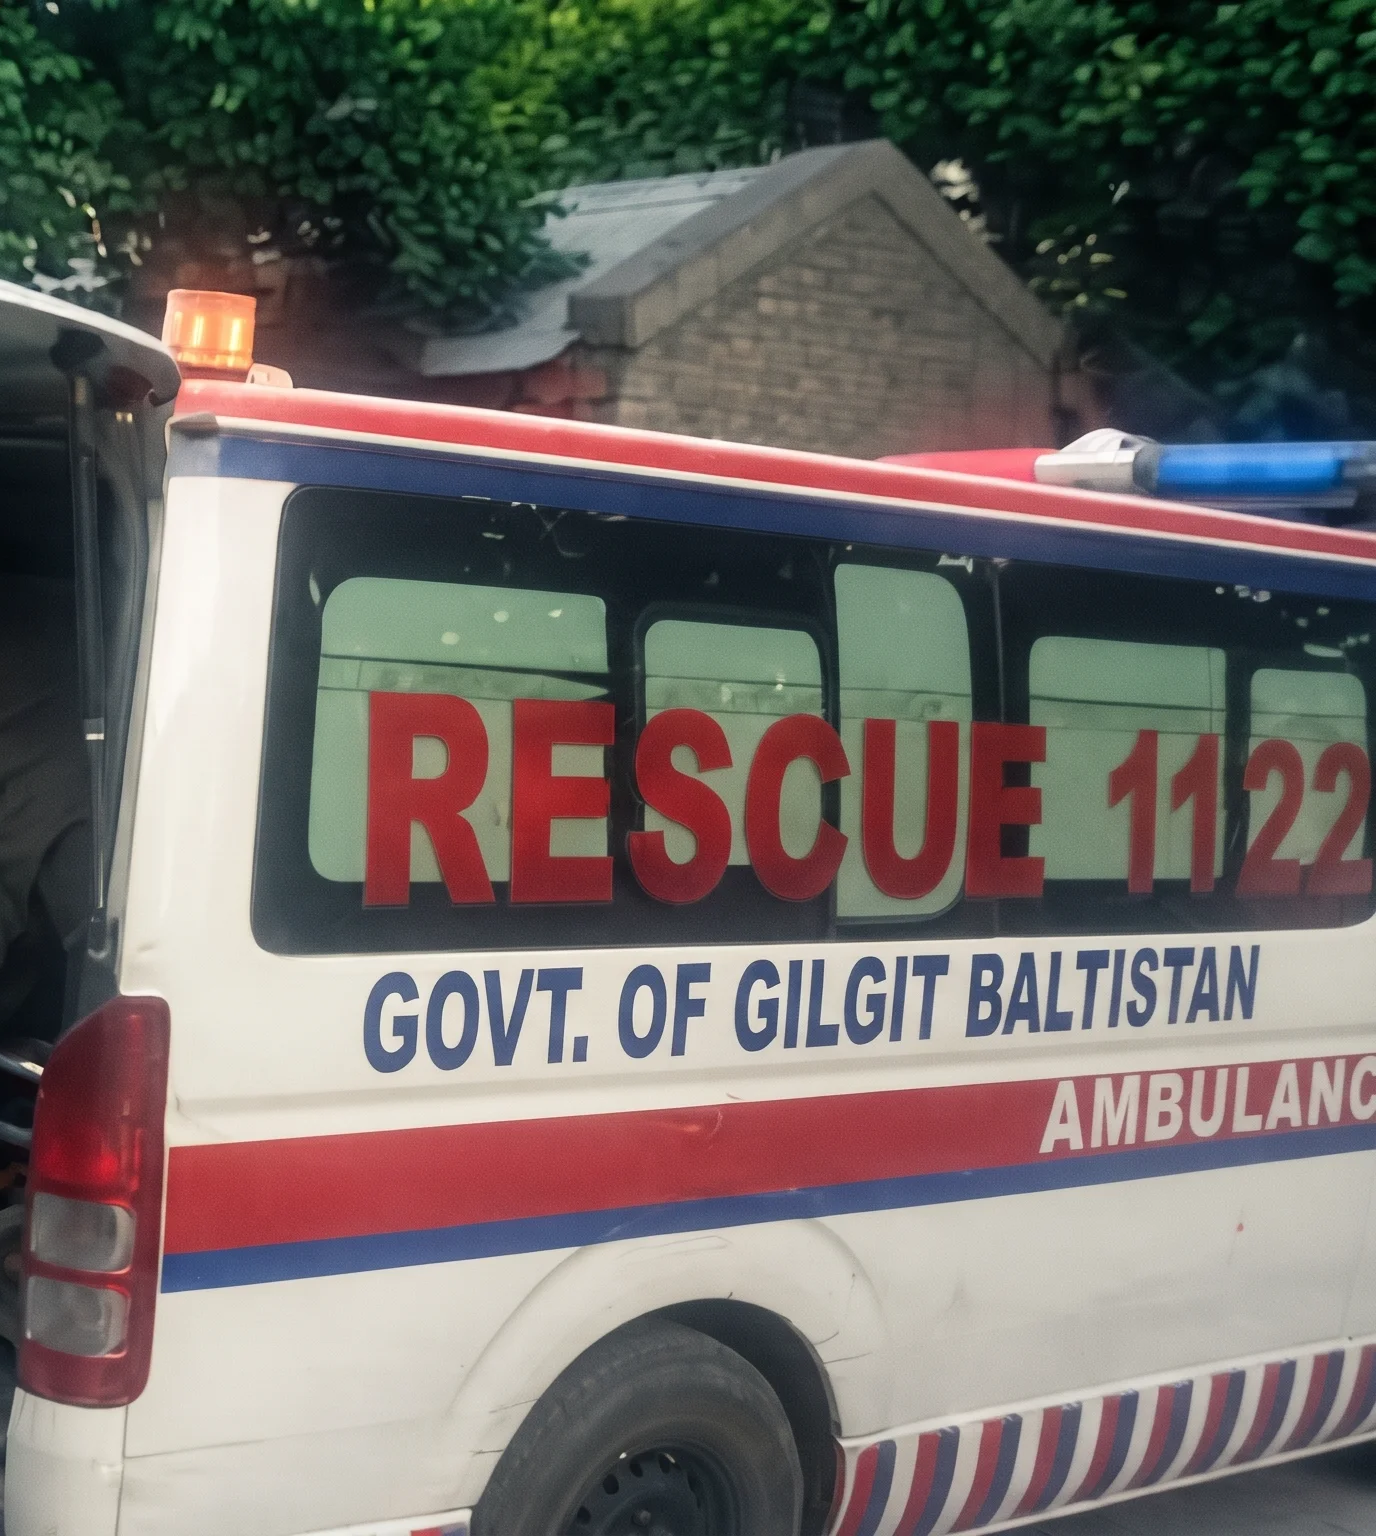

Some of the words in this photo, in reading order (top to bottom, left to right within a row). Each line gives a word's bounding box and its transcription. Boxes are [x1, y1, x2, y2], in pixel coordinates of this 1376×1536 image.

[363, 690, 1046, 907] RESCUE
[1108, 729, 1374, 897] 1122
[363, 966, 588, 1073] GOVT.
[618, 963, 711, 1059] OF
[734, 954, 950, 1052] GILGIT
[965, 945, 1260, 1038] BALTISTAN
